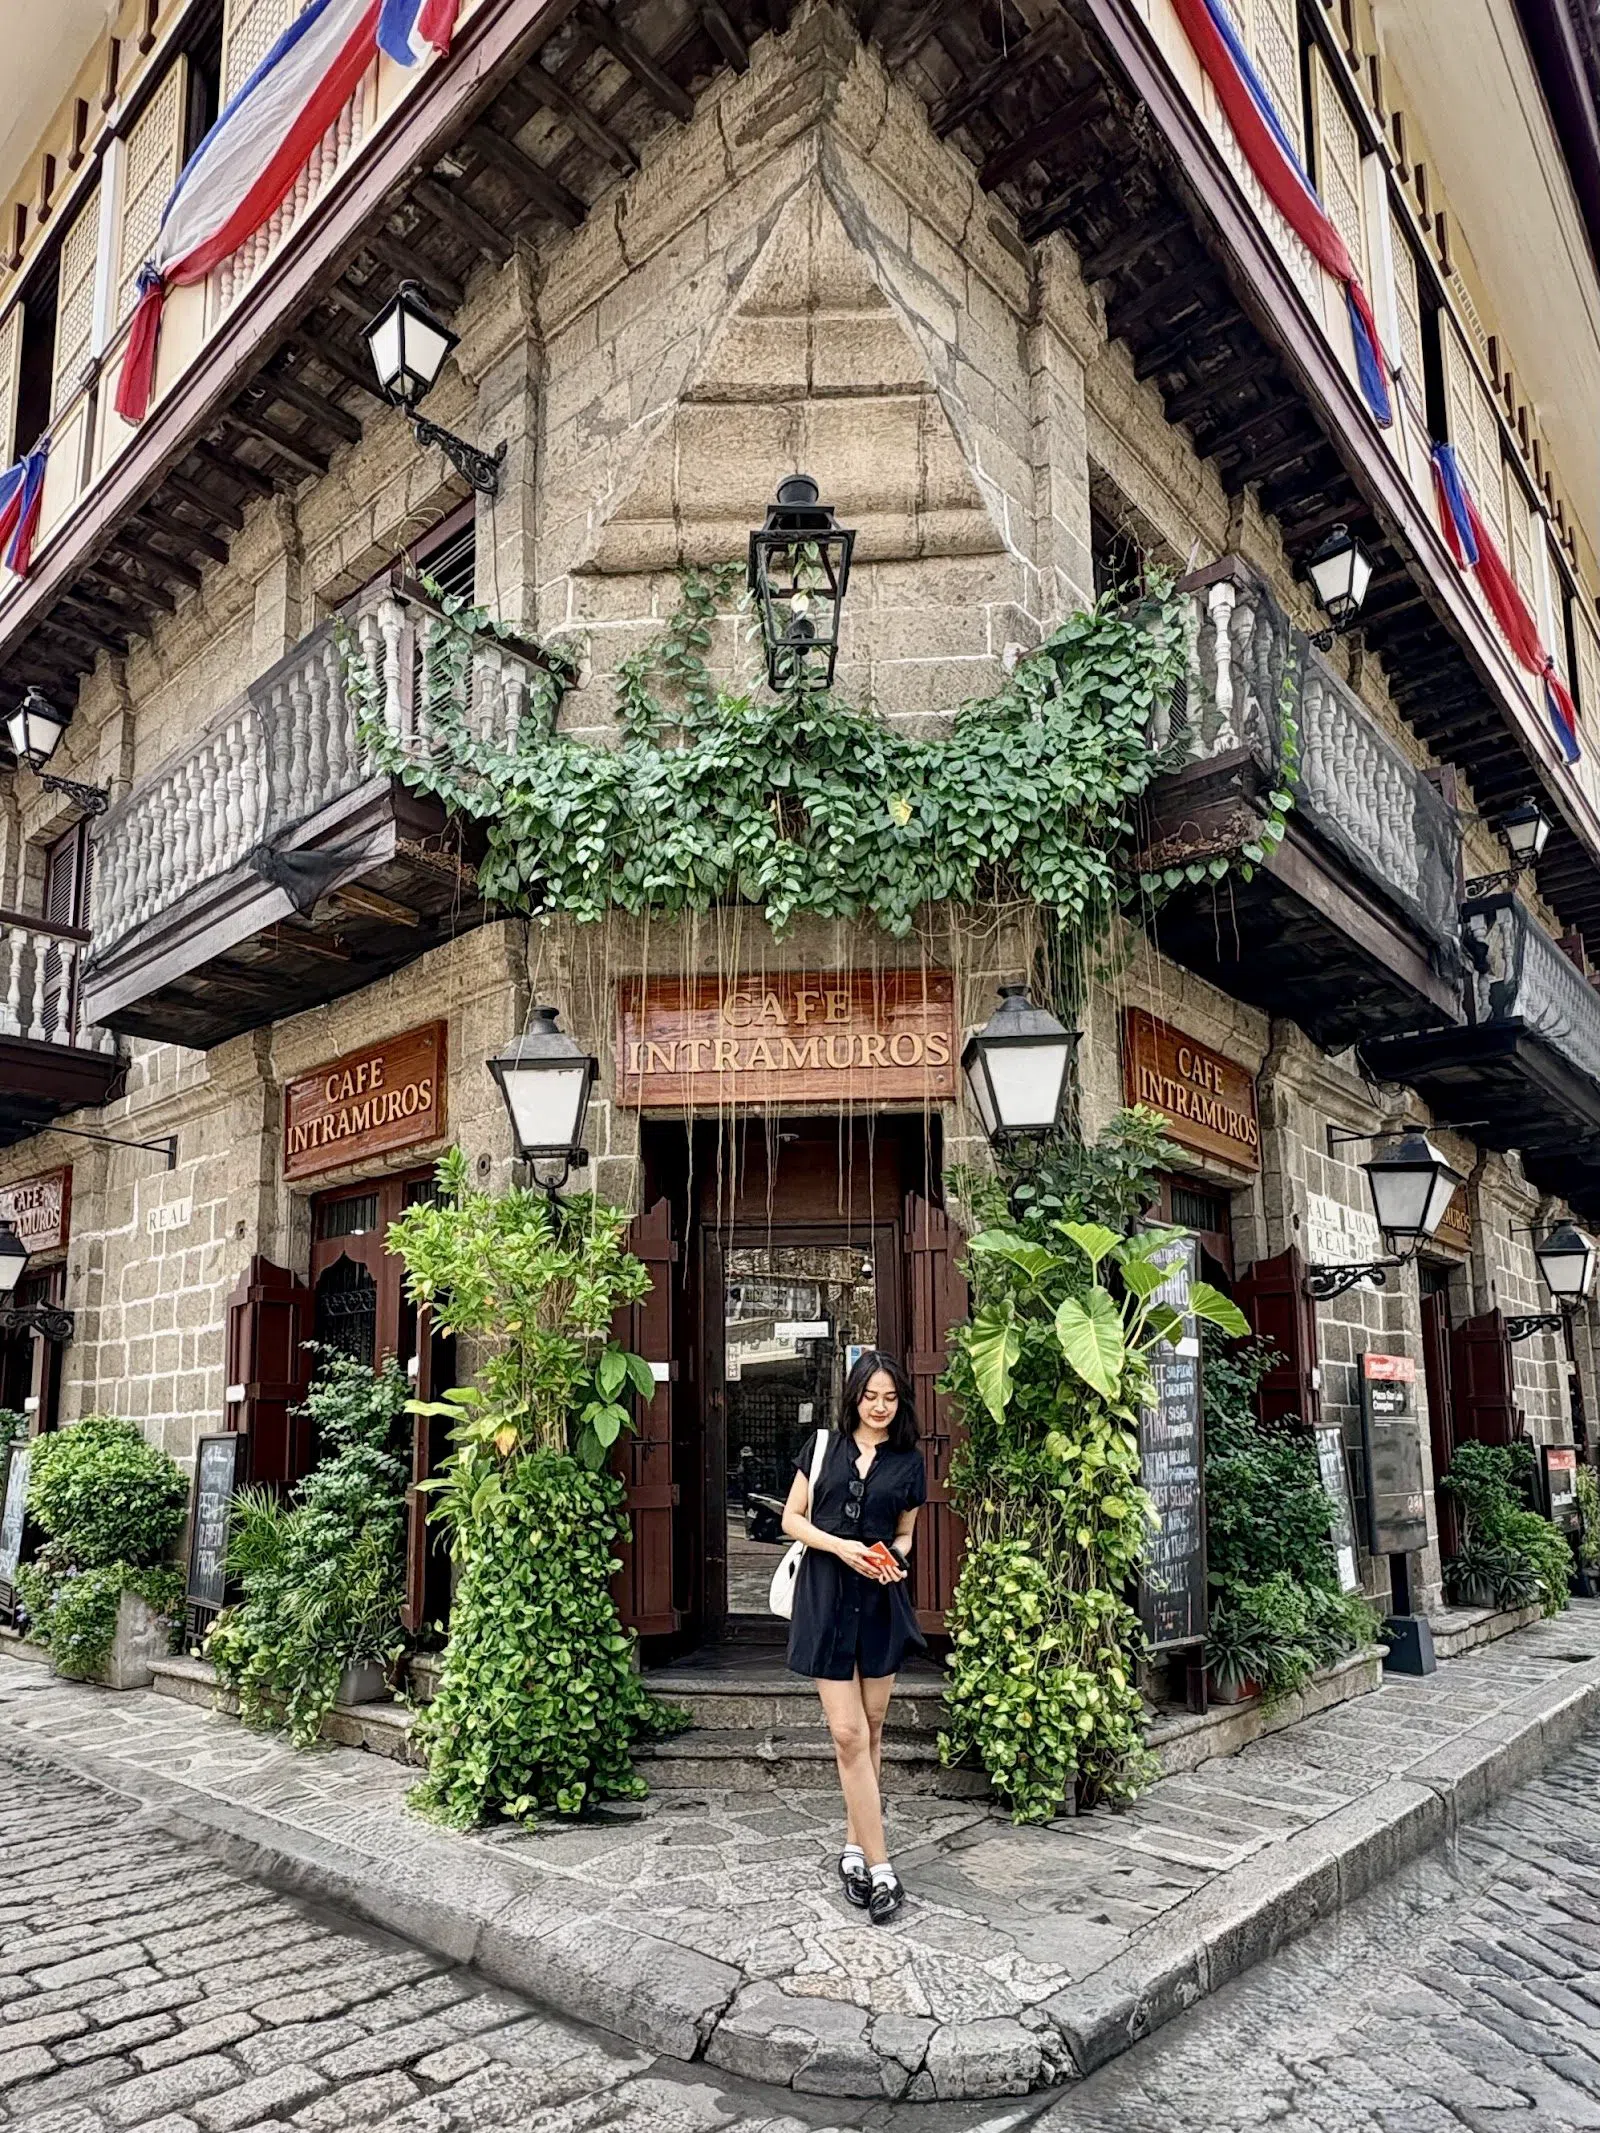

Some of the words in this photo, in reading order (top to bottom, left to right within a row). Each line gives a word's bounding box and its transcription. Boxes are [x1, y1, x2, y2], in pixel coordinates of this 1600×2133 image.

[723, 990, 853, 1027] CAFE
[626, 1031, 951, 1076] INTRAMUROS
[1178, 1047, 1225, 1096] CAFE
[325, 1057, 385, 1104] CAFE
[287, 1078, 433, 1155] INTRAMUROS
[1140, 1066, 1258, 1146] INTRAMUROS
[14, 1186, 42, 1213] CAFE
[150, 1203, 188, 1229] REAL
[14, 1205, 60, 1239] AMUROS
[1316, 1229, 1349, 1256] REAL
